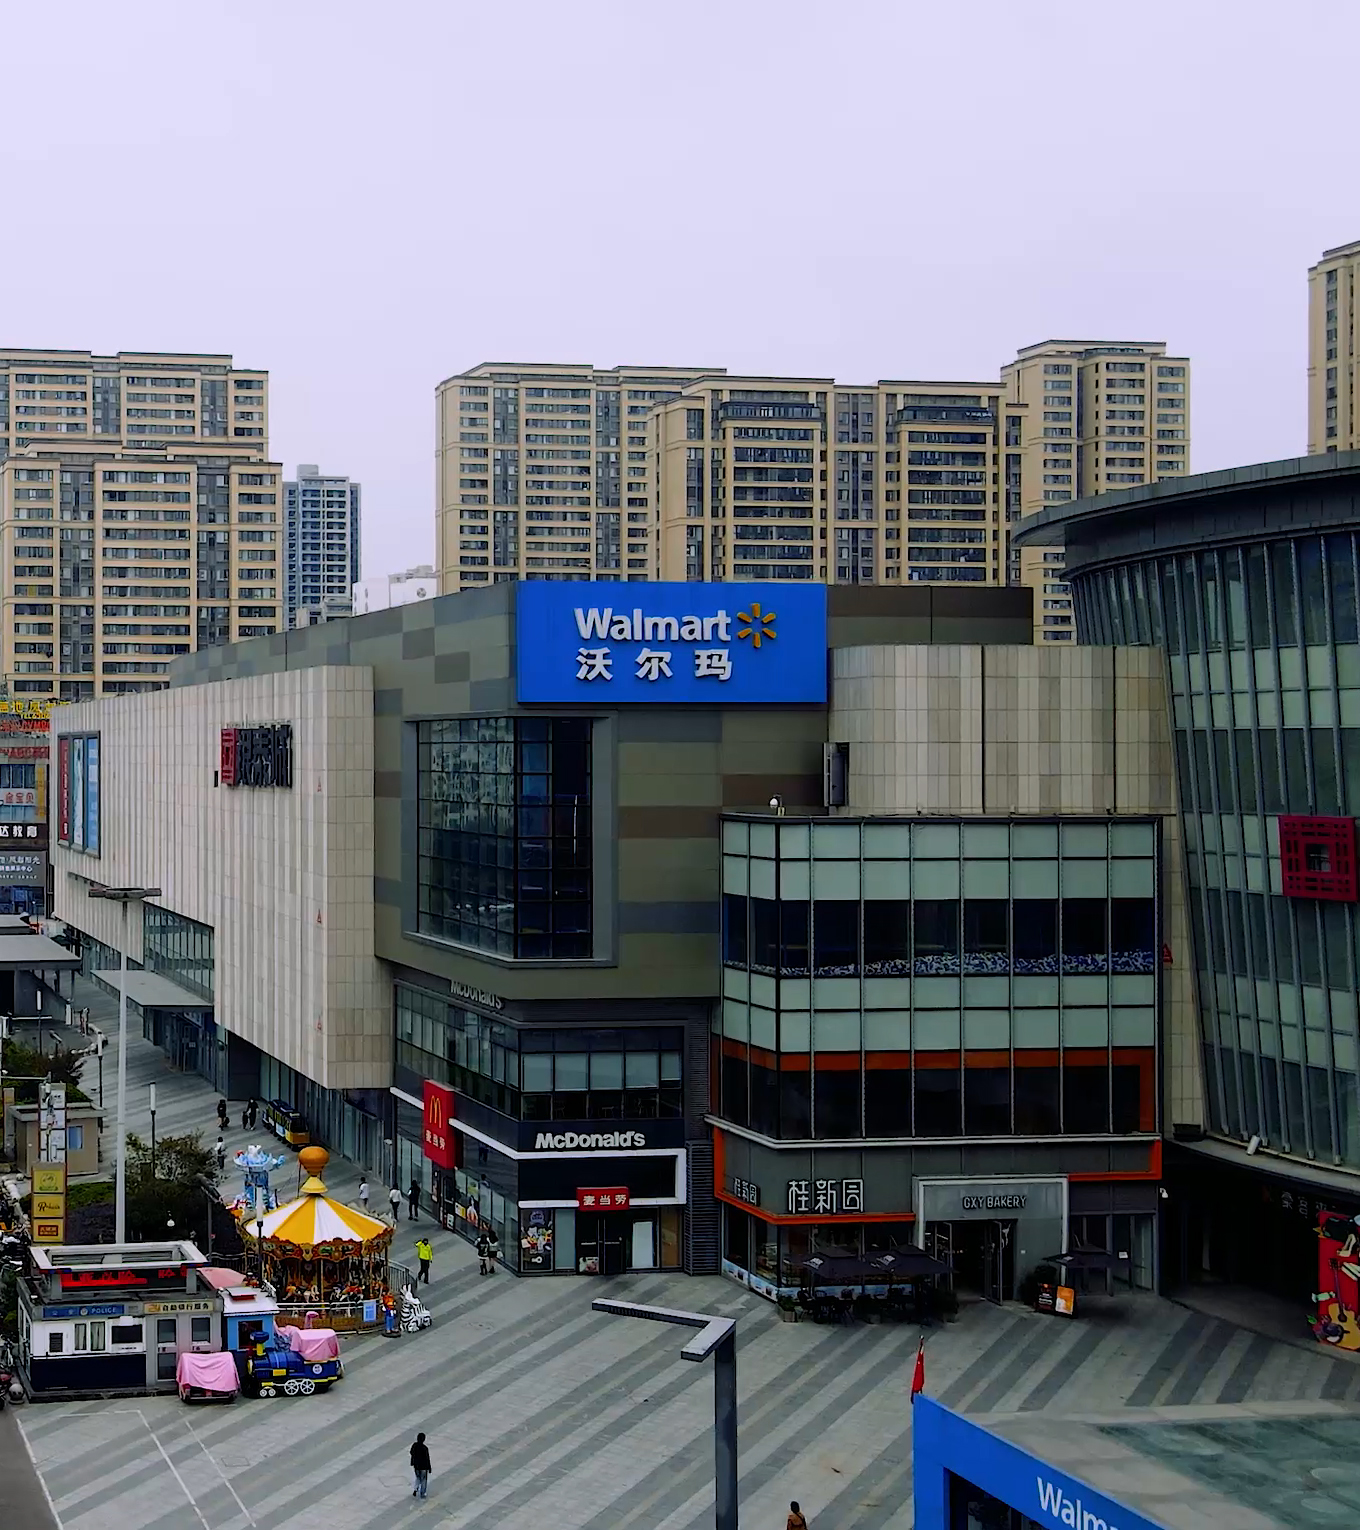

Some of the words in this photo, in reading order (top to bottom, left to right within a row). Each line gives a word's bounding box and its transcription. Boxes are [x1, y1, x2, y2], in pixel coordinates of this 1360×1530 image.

[574, 607, 731, 642] Walmart
[575, 648, 732, 681] 沃尔玛
[425, 1129, 446, 1151] 麦当劳
[535, 1131, 645, 1149] McDonald's
[583, 1195, 627, 1206] 麦当劳
[788, 1177, 864, 1213] 桂新园
[963, 1196, 985, 1208] GXY
[987, 1195, 1027, 1208] BAKERY
[91, 1306, 116, 1314] POLICE
[1036, 1476, 1118, 1530] Walm
